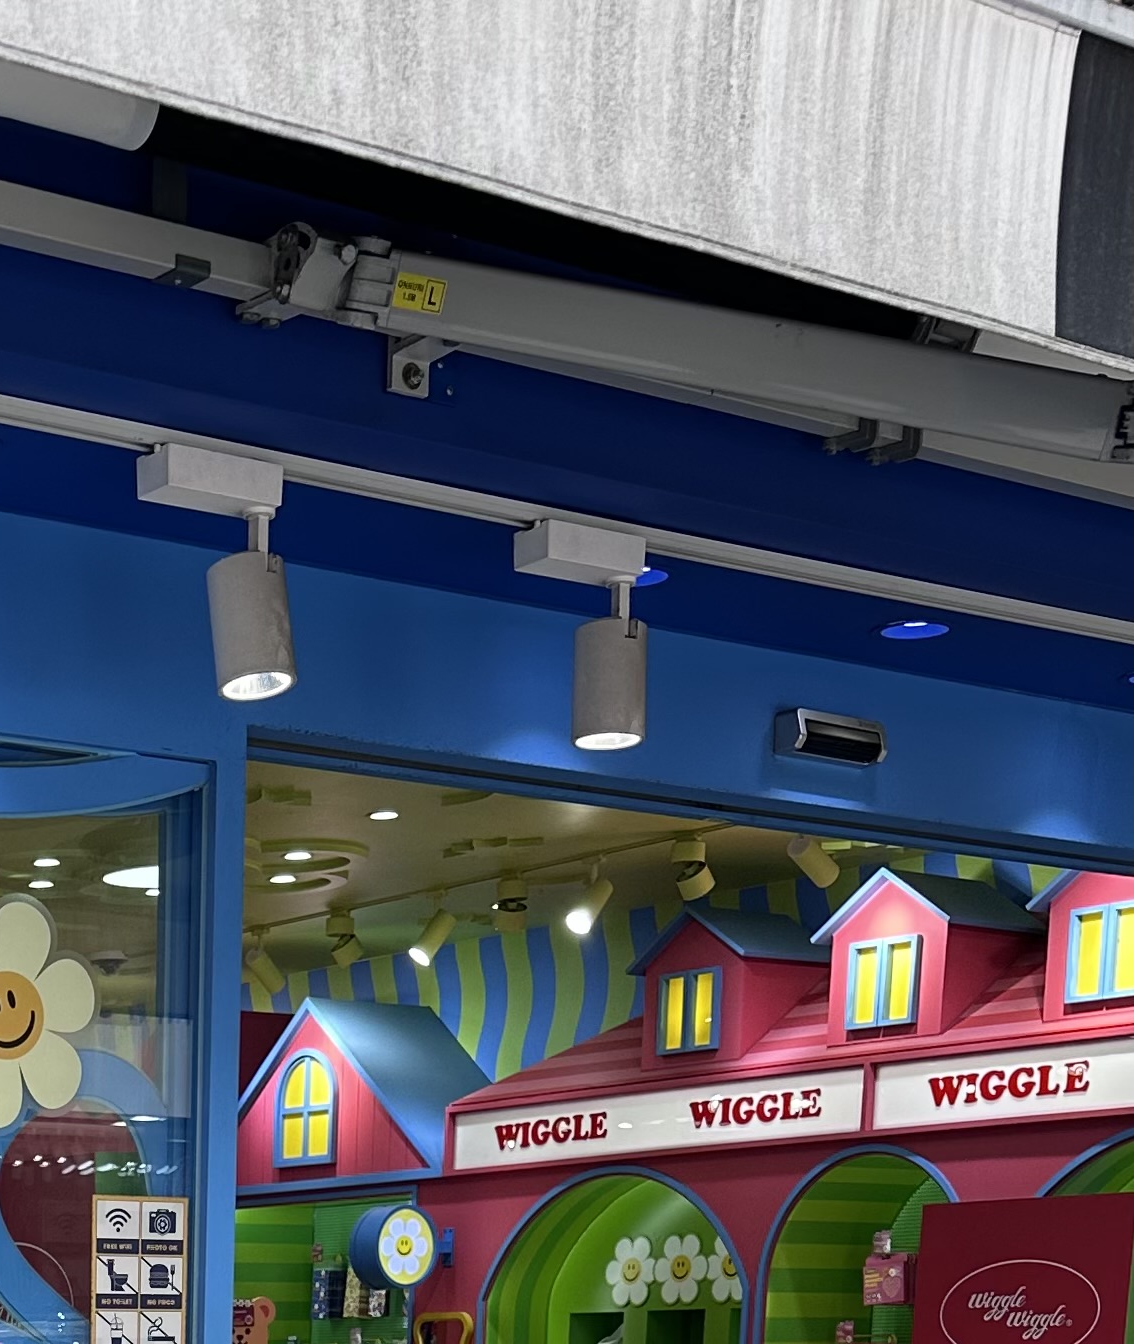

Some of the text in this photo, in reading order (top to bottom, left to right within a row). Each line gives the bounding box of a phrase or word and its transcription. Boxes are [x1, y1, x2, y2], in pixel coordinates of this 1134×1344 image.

[428, 286, 436, 306] L
[929, 1060, 1091, 1108] WIGGLE
[495, 1088, 822, 1151] WIGGLE WIGGLE
